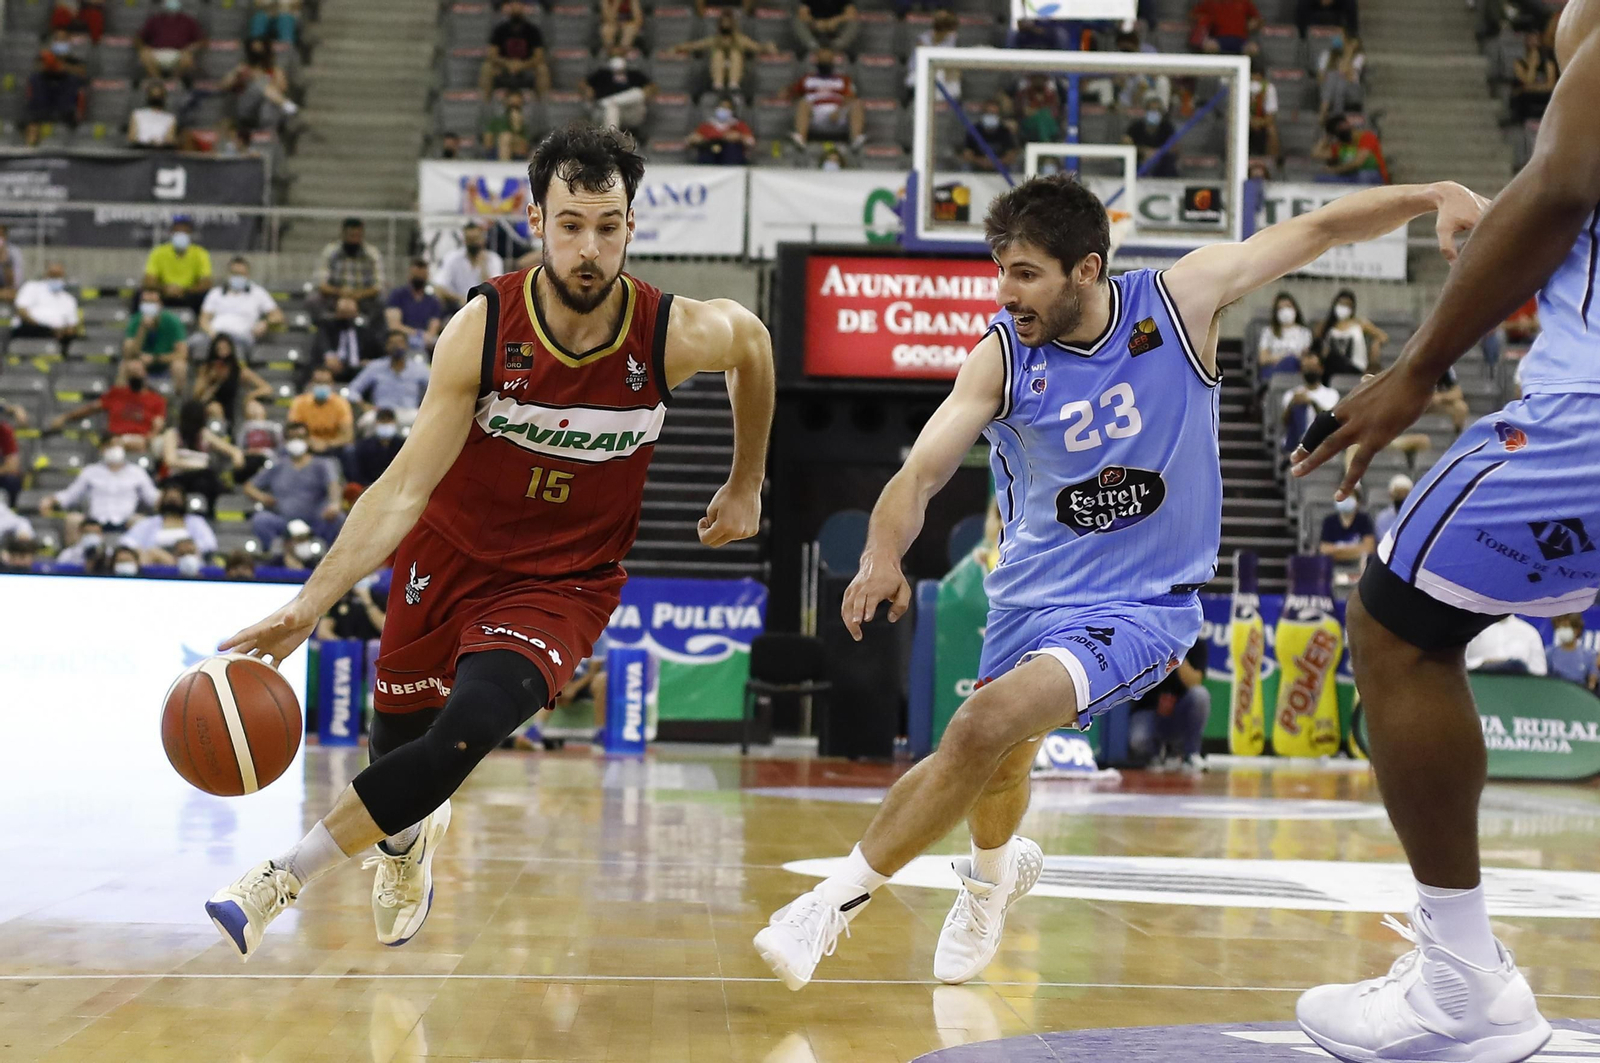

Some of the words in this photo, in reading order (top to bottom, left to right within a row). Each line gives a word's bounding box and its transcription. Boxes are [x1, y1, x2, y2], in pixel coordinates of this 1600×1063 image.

[837, 308, 878, 333] DE
[1129, 334, 1149, 349] LEB
[1059, 382, 1142, 452] 23
[525, 466, 575, 504] 15
[1068, 483, 1150, 512] Estrell
[1475, 528, 1530, 565] TORRE
[1532, 562, 1549, 573] DE
[652, 602, 762, 629] PULEVA
[1064, 635, 1109, 672] NDELAS
[330, 657, 352, 737] PULEVA
[1278, 629, 1339, 736] POWER
[622, 661, 643, 742] PULEVA
[1485, 736, 1573, 754] RANADA
